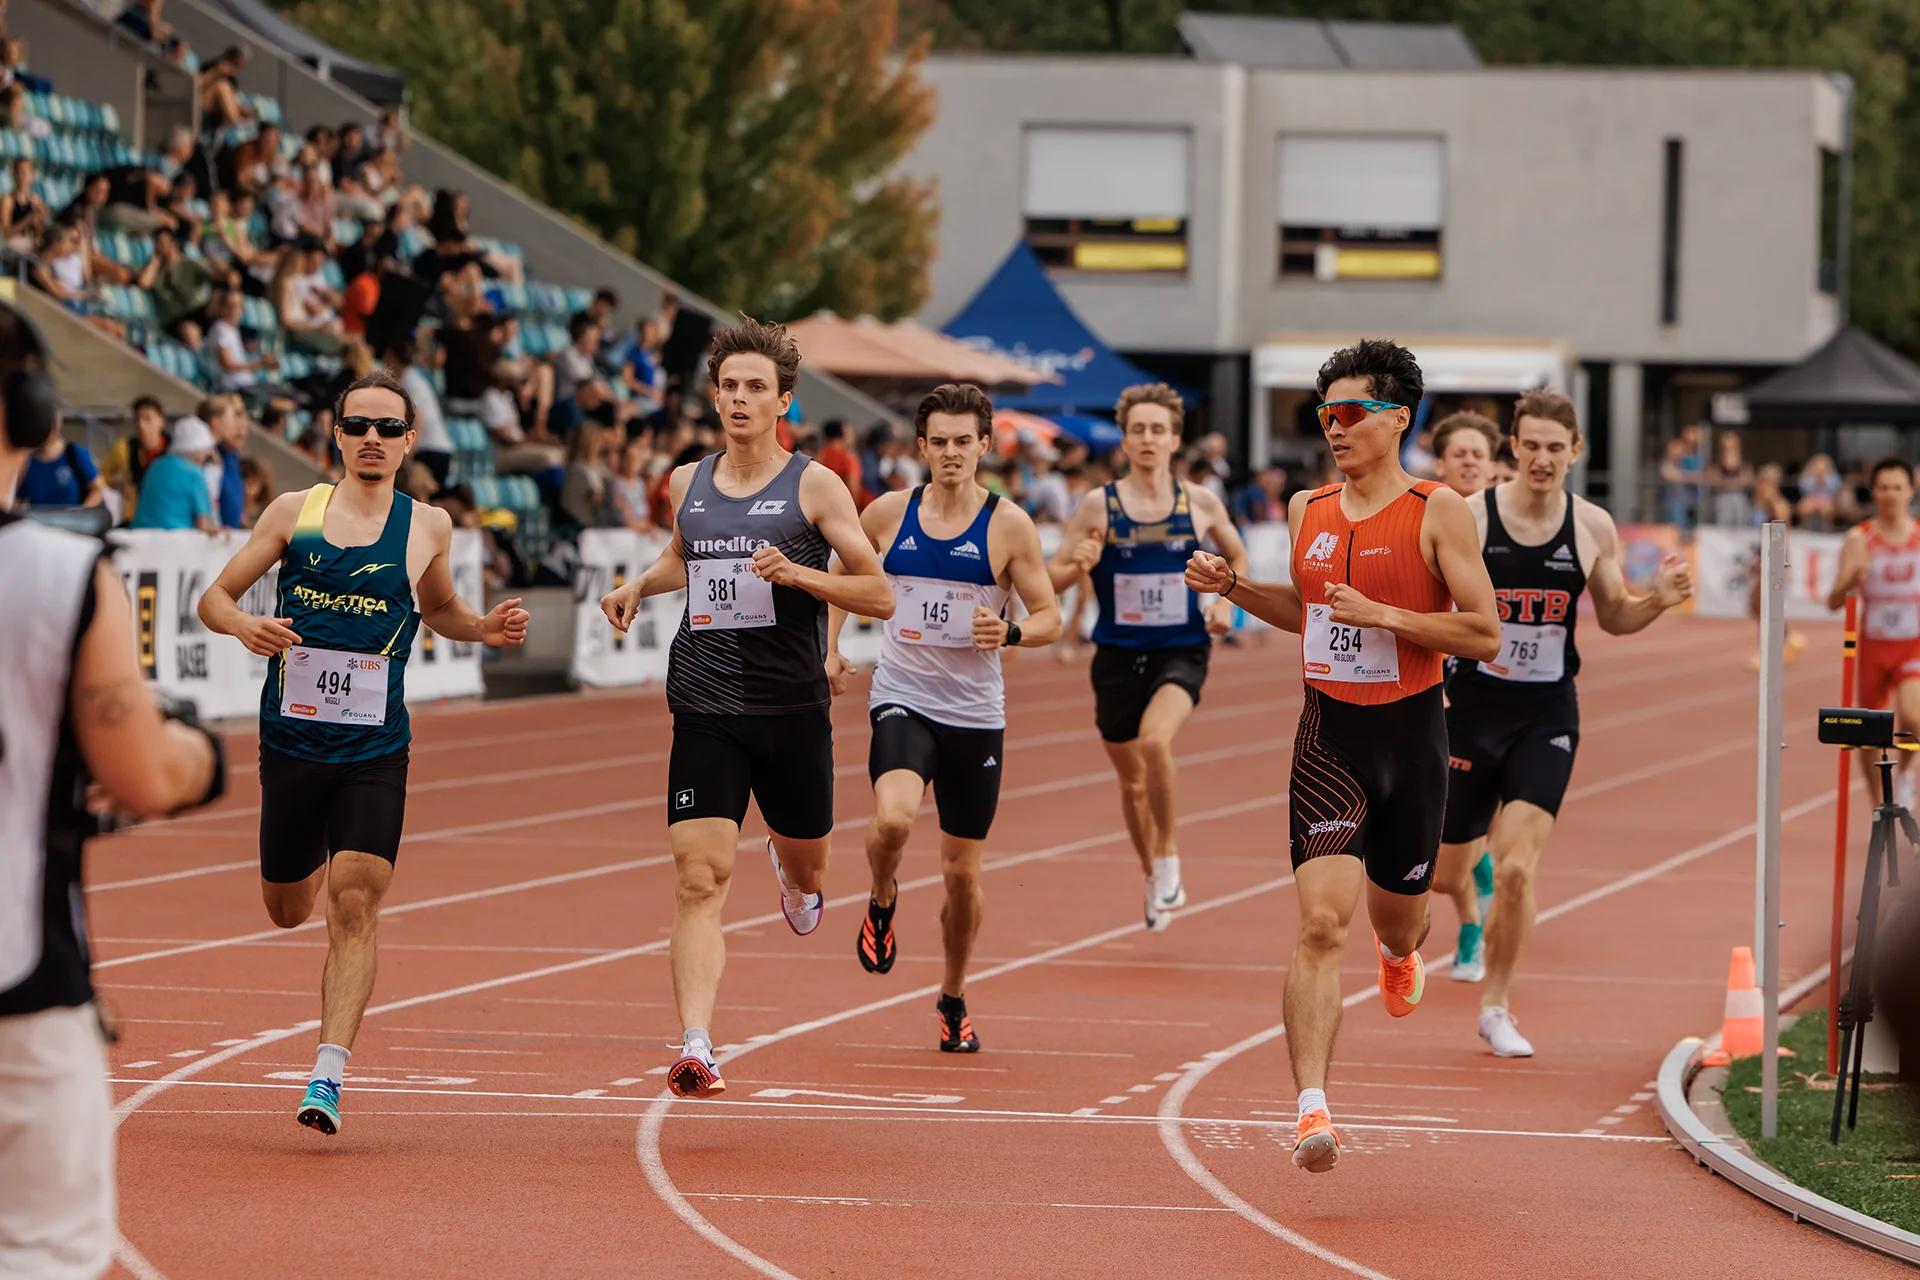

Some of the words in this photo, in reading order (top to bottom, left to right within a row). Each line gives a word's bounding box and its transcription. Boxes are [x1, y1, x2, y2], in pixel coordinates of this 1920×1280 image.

[693, 536, 770, 553] medica
[1359, 547, 1384, 557] CRAFT
[293, 585, 388, 613] ATHLETICA
[708, 578, 737, 602] 381
[922, 601, 949, 623] 145
[1495, 588, 1570, 622] STB
[1329, 626, 1362, 652] 254
[1510, 640, 1539, 660] 763
[360, 660, 381, 671] UBS
[316, 670, 352, 697] 494
[349, 711, 377, 719] EQUANS
[1308, 826, 1340, 836] SPORT
[1311, 820, 1357, 829] OCHSNER
